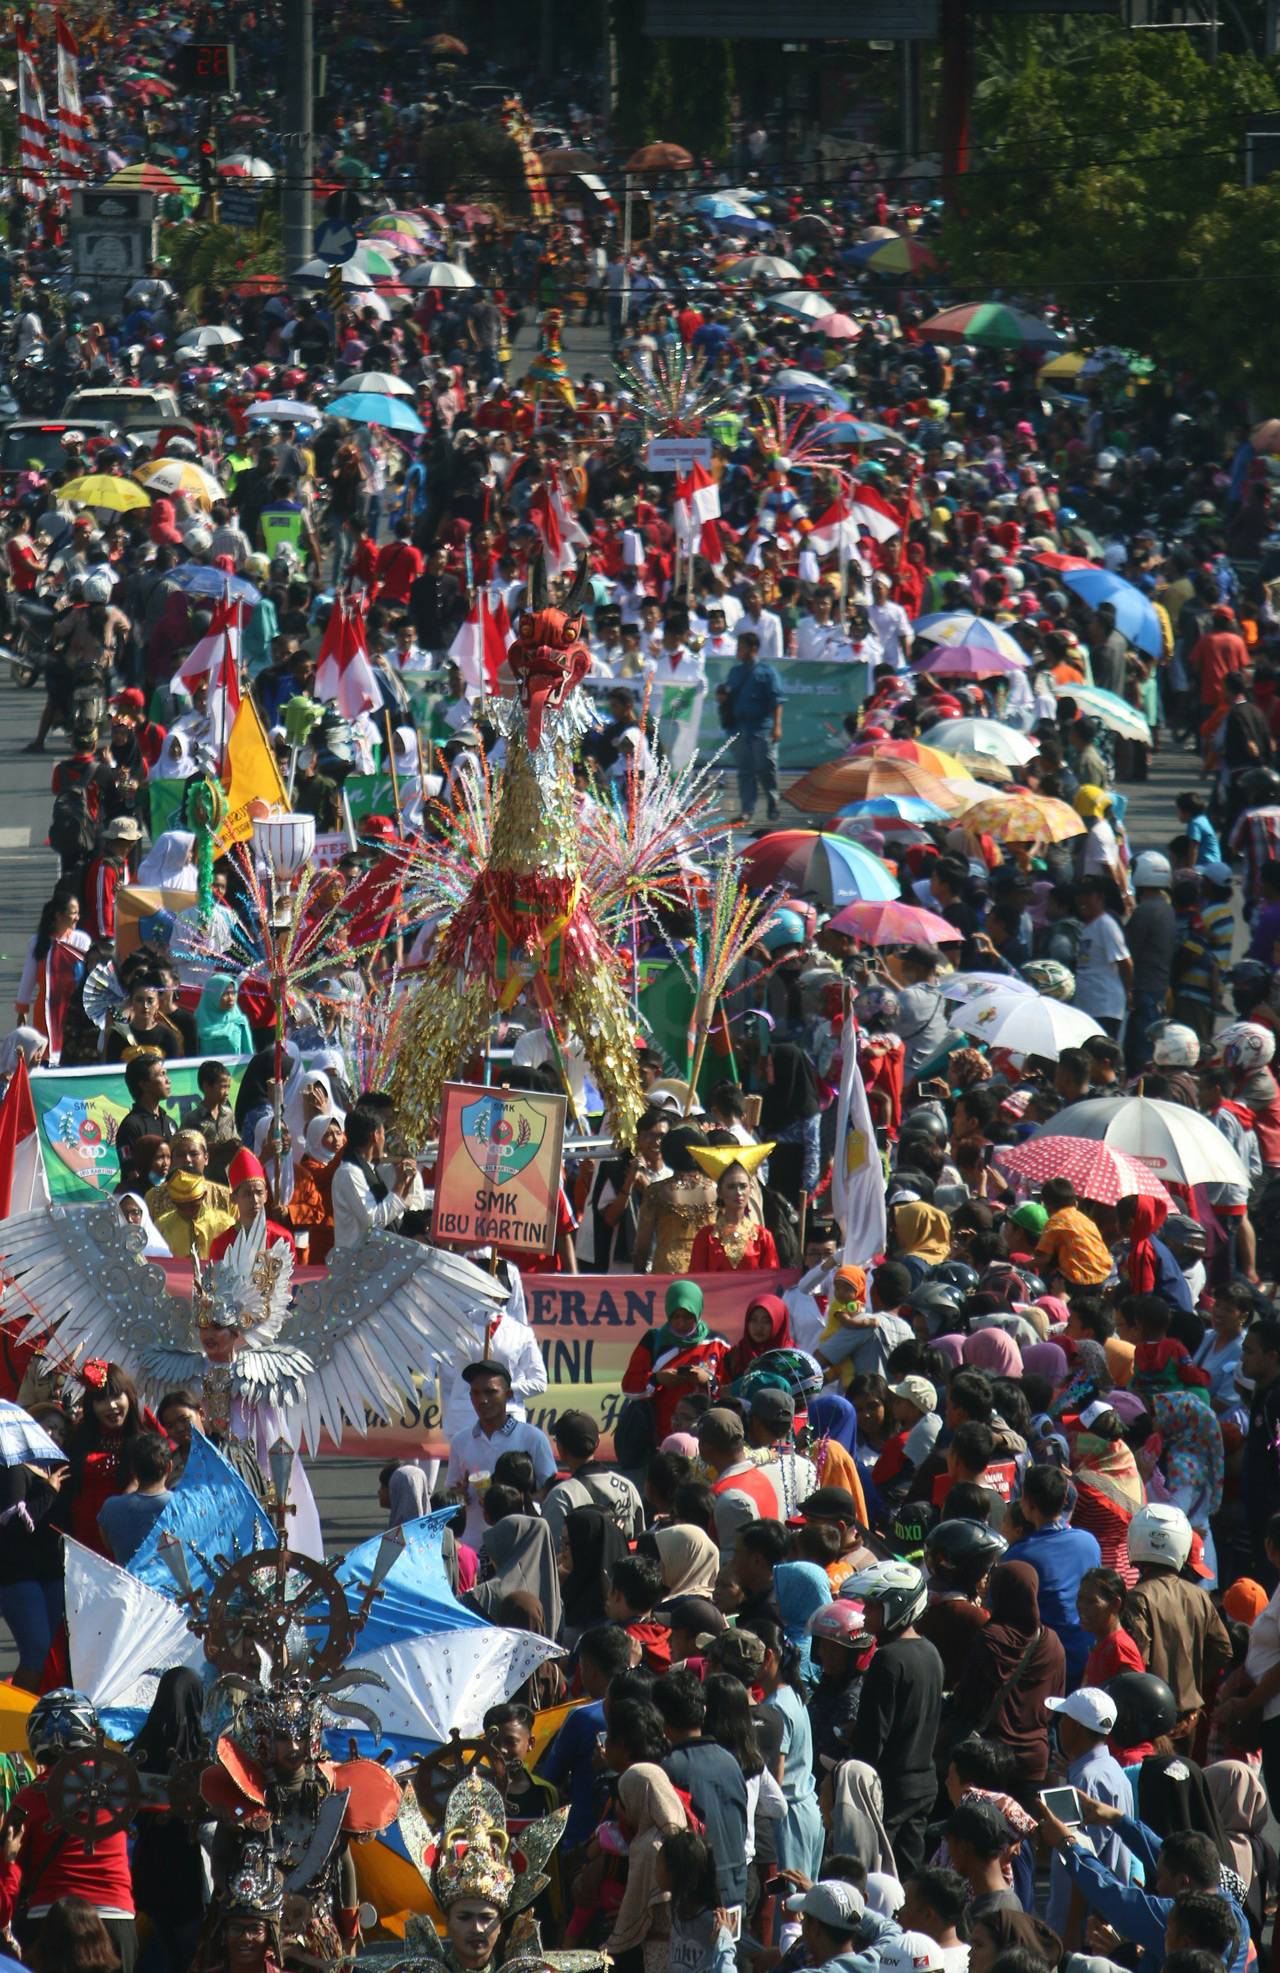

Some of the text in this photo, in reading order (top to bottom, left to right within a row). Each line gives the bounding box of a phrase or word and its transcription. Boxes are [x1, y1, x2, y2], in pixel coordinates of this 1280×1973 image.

[74, 1102, 96, 1111] SMK
[493, 1103, 515, 1113] SMK
[475, 1190, 518, 1216] SMK
[439, 1213, 548, 1244] IBU KARTINI
[525, 1290, 656, 1326] ERAN
